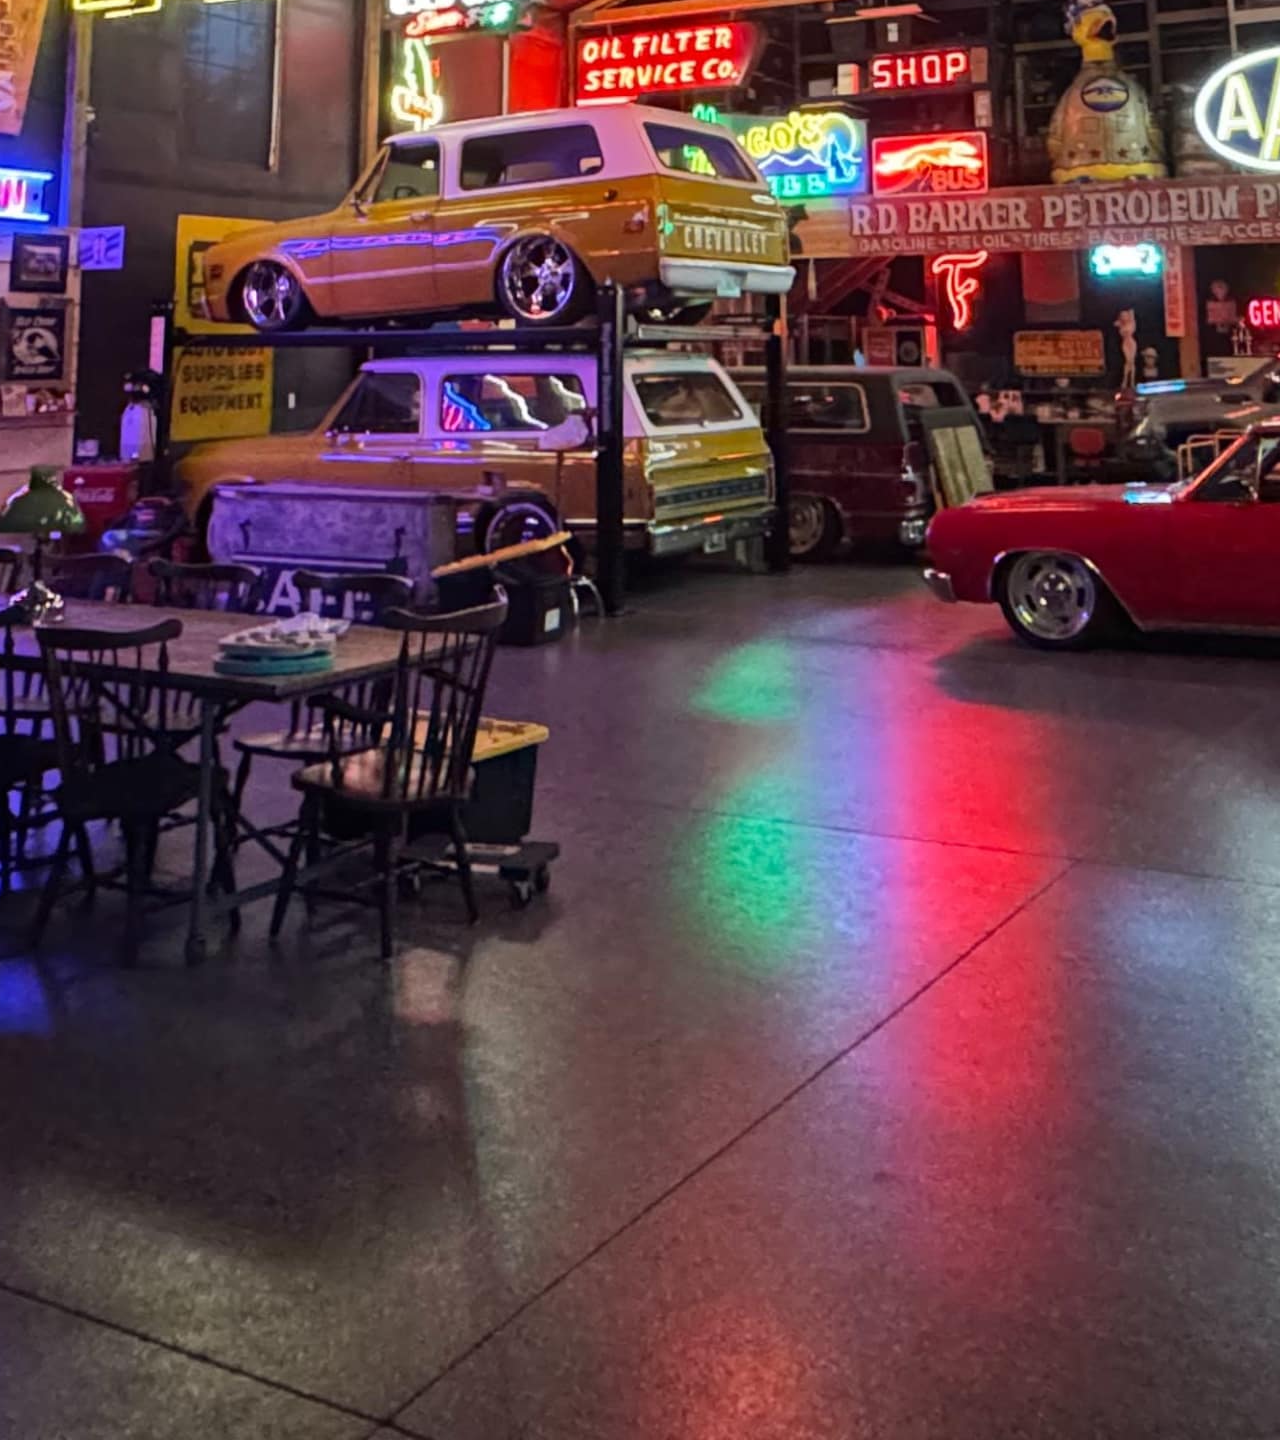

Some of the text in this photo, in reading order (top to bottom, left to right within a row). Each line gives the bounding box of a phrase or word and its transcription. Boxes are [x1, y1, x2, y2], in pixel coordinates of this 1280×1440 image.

[582, 26, 733, 65] OIL FILTER
[583, 57, 741, 92] SERVICE CO.
[872, 51, 967, 89] SHOP
[931, 167, 982, 193] BUS
[907, 197, 1032, 235] BARKER
[1039, 184, 1240, 230] PETROLEUM
[182, 363, 265, 384] SUPPLIES
[179, 392, 264, 416] EQUIPMENT
